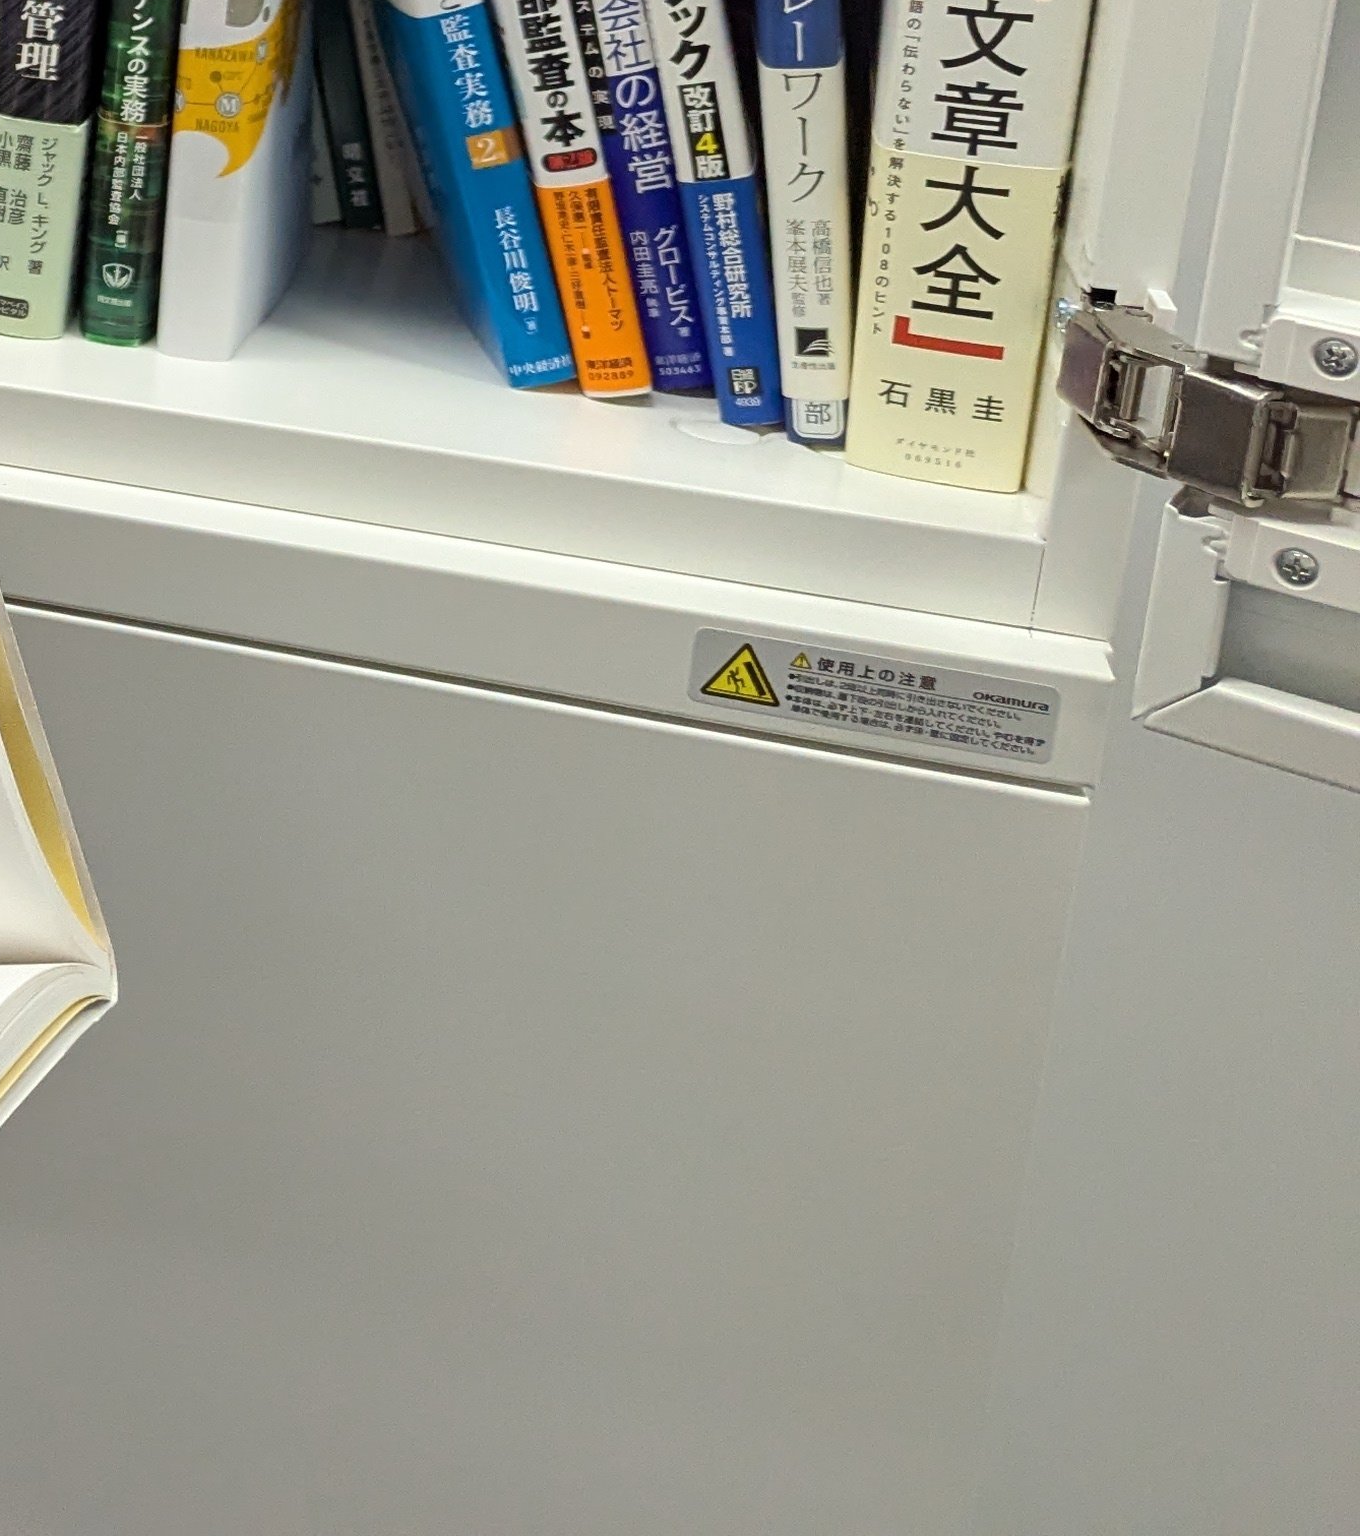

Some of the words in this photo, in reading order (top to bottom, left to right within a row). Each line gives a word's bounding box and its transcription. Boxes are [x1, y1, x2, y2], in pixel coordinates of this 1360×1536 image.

[195, 118, 241, 134] NAGOYA
[682, 86, 727, 179] 改訂4版
[36, 136, 59, 187] ジャック
[108, 132, 128, 225] 日本内部監査協会
[128, 137, 149, 201] 一般社団法人
[28, 215, 49, 255] キング
[495, 206, 541, 314] 長谷川俊明
[712, 192, 754, 319] 野村総合研究所
[811, 218, 834, 292] 高橋信也
[653, 225, 695, 326] グロービス
[804, 402, 831, 426] 部
[817, 657, 937, 691] 使用上の注意
